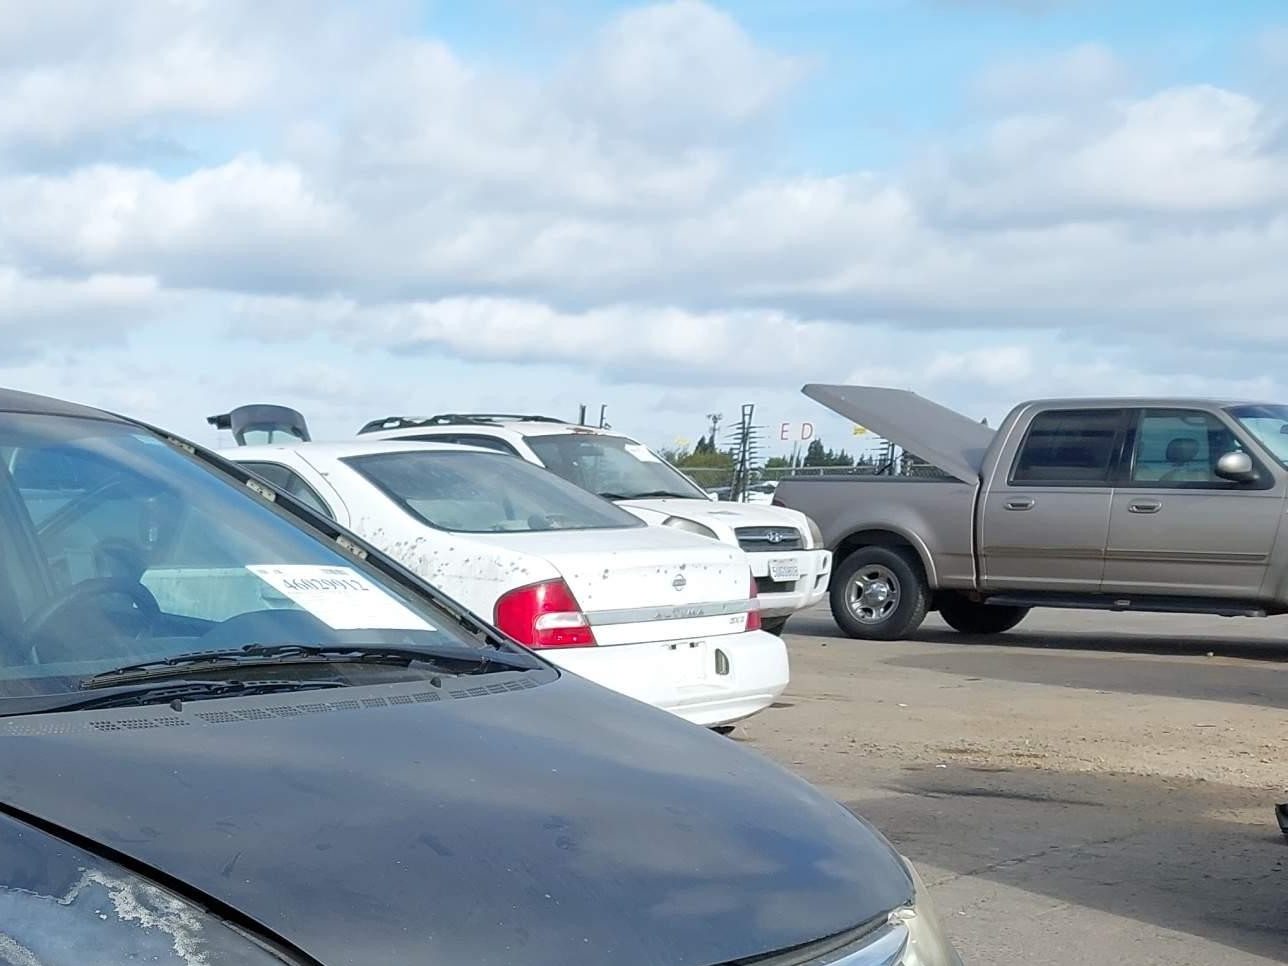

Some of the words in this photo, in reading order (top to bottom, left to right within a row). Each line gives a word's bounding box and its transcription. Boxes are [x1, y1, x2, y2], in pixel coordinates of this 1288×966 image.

[780, 423, 791, 440] E
[801, 423, 813, 440] D
[282, 578, 369, 591] 46029912
